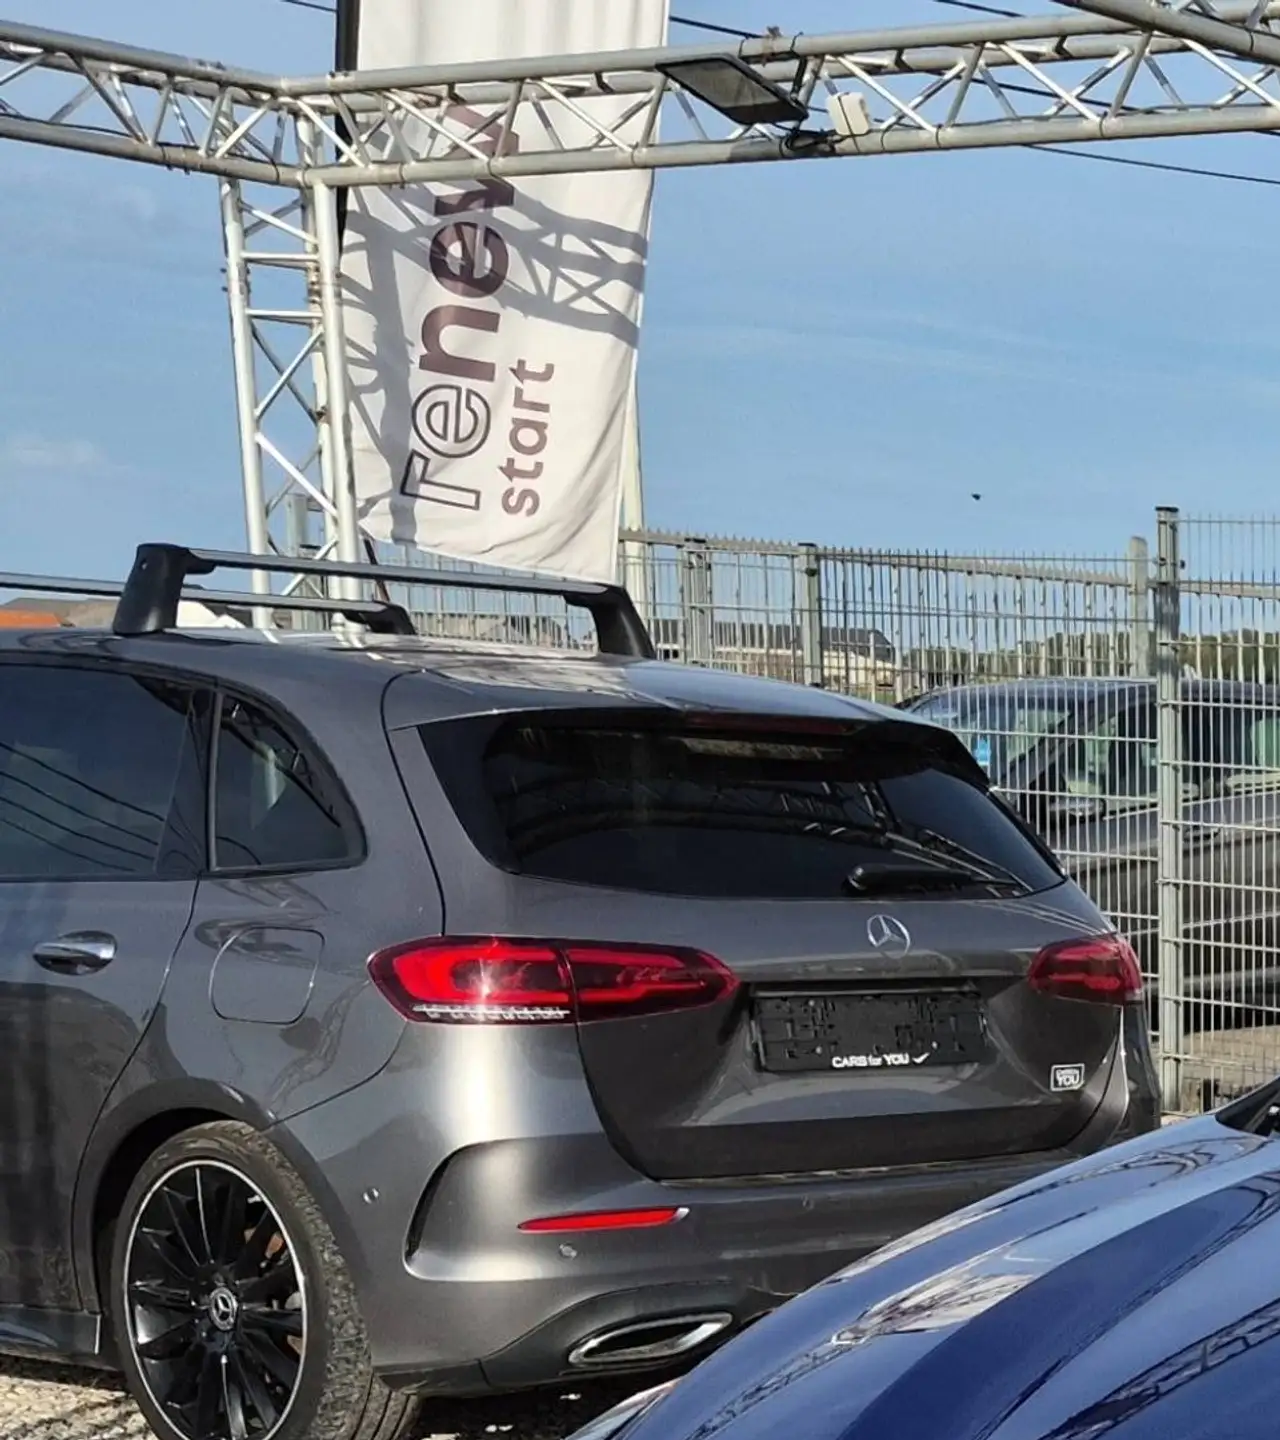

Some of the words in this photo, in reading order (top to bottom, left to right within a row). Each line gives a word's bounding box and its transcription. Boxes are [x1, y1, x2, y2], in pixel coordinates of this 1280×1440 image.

[400, 97, 519, 511] renew
[498, 358, 555, 518] start
[832, 1056, 868, 1068] CARS
[882, 1052, 910, 1066] YOU
